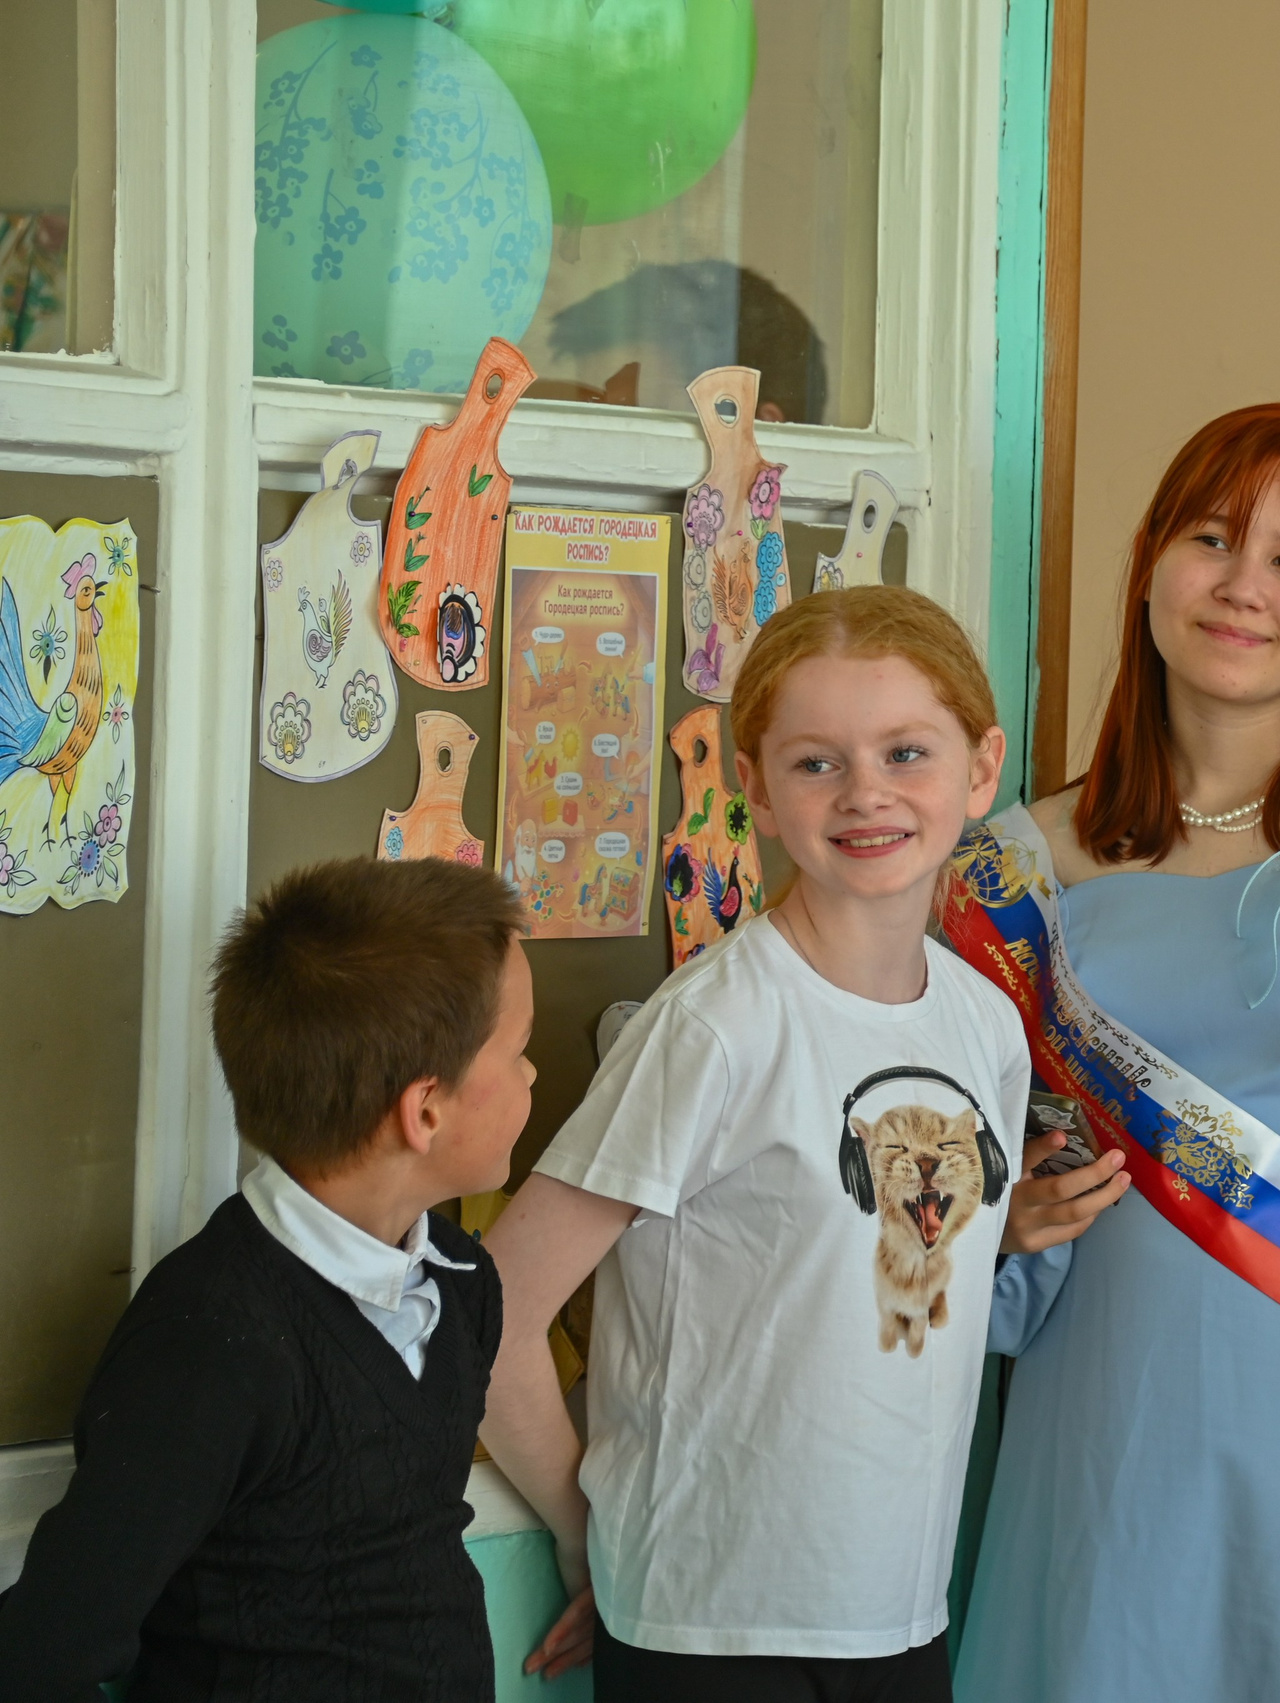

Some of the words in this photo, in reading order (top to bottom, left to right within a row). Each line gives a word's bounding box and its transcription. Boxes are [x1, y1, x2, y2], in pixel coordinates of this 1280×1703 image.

[514, 514, 535, 531] КАК
[537, 515, 595, 536] РОЖДАЕТСЯ
[598, 519, 657, 540] ГОРОДЕЦКАЯ
[567, 543, 610, 561] РОСПИСЬ?
[557, 584, 571, 597] Как
[572, 588, 613, 601] рождается
[544, 600, 587, 616] Городецкая
[589, 603, 625, 617] роспись?
[1065, 1053, 1132, 1130] школы
